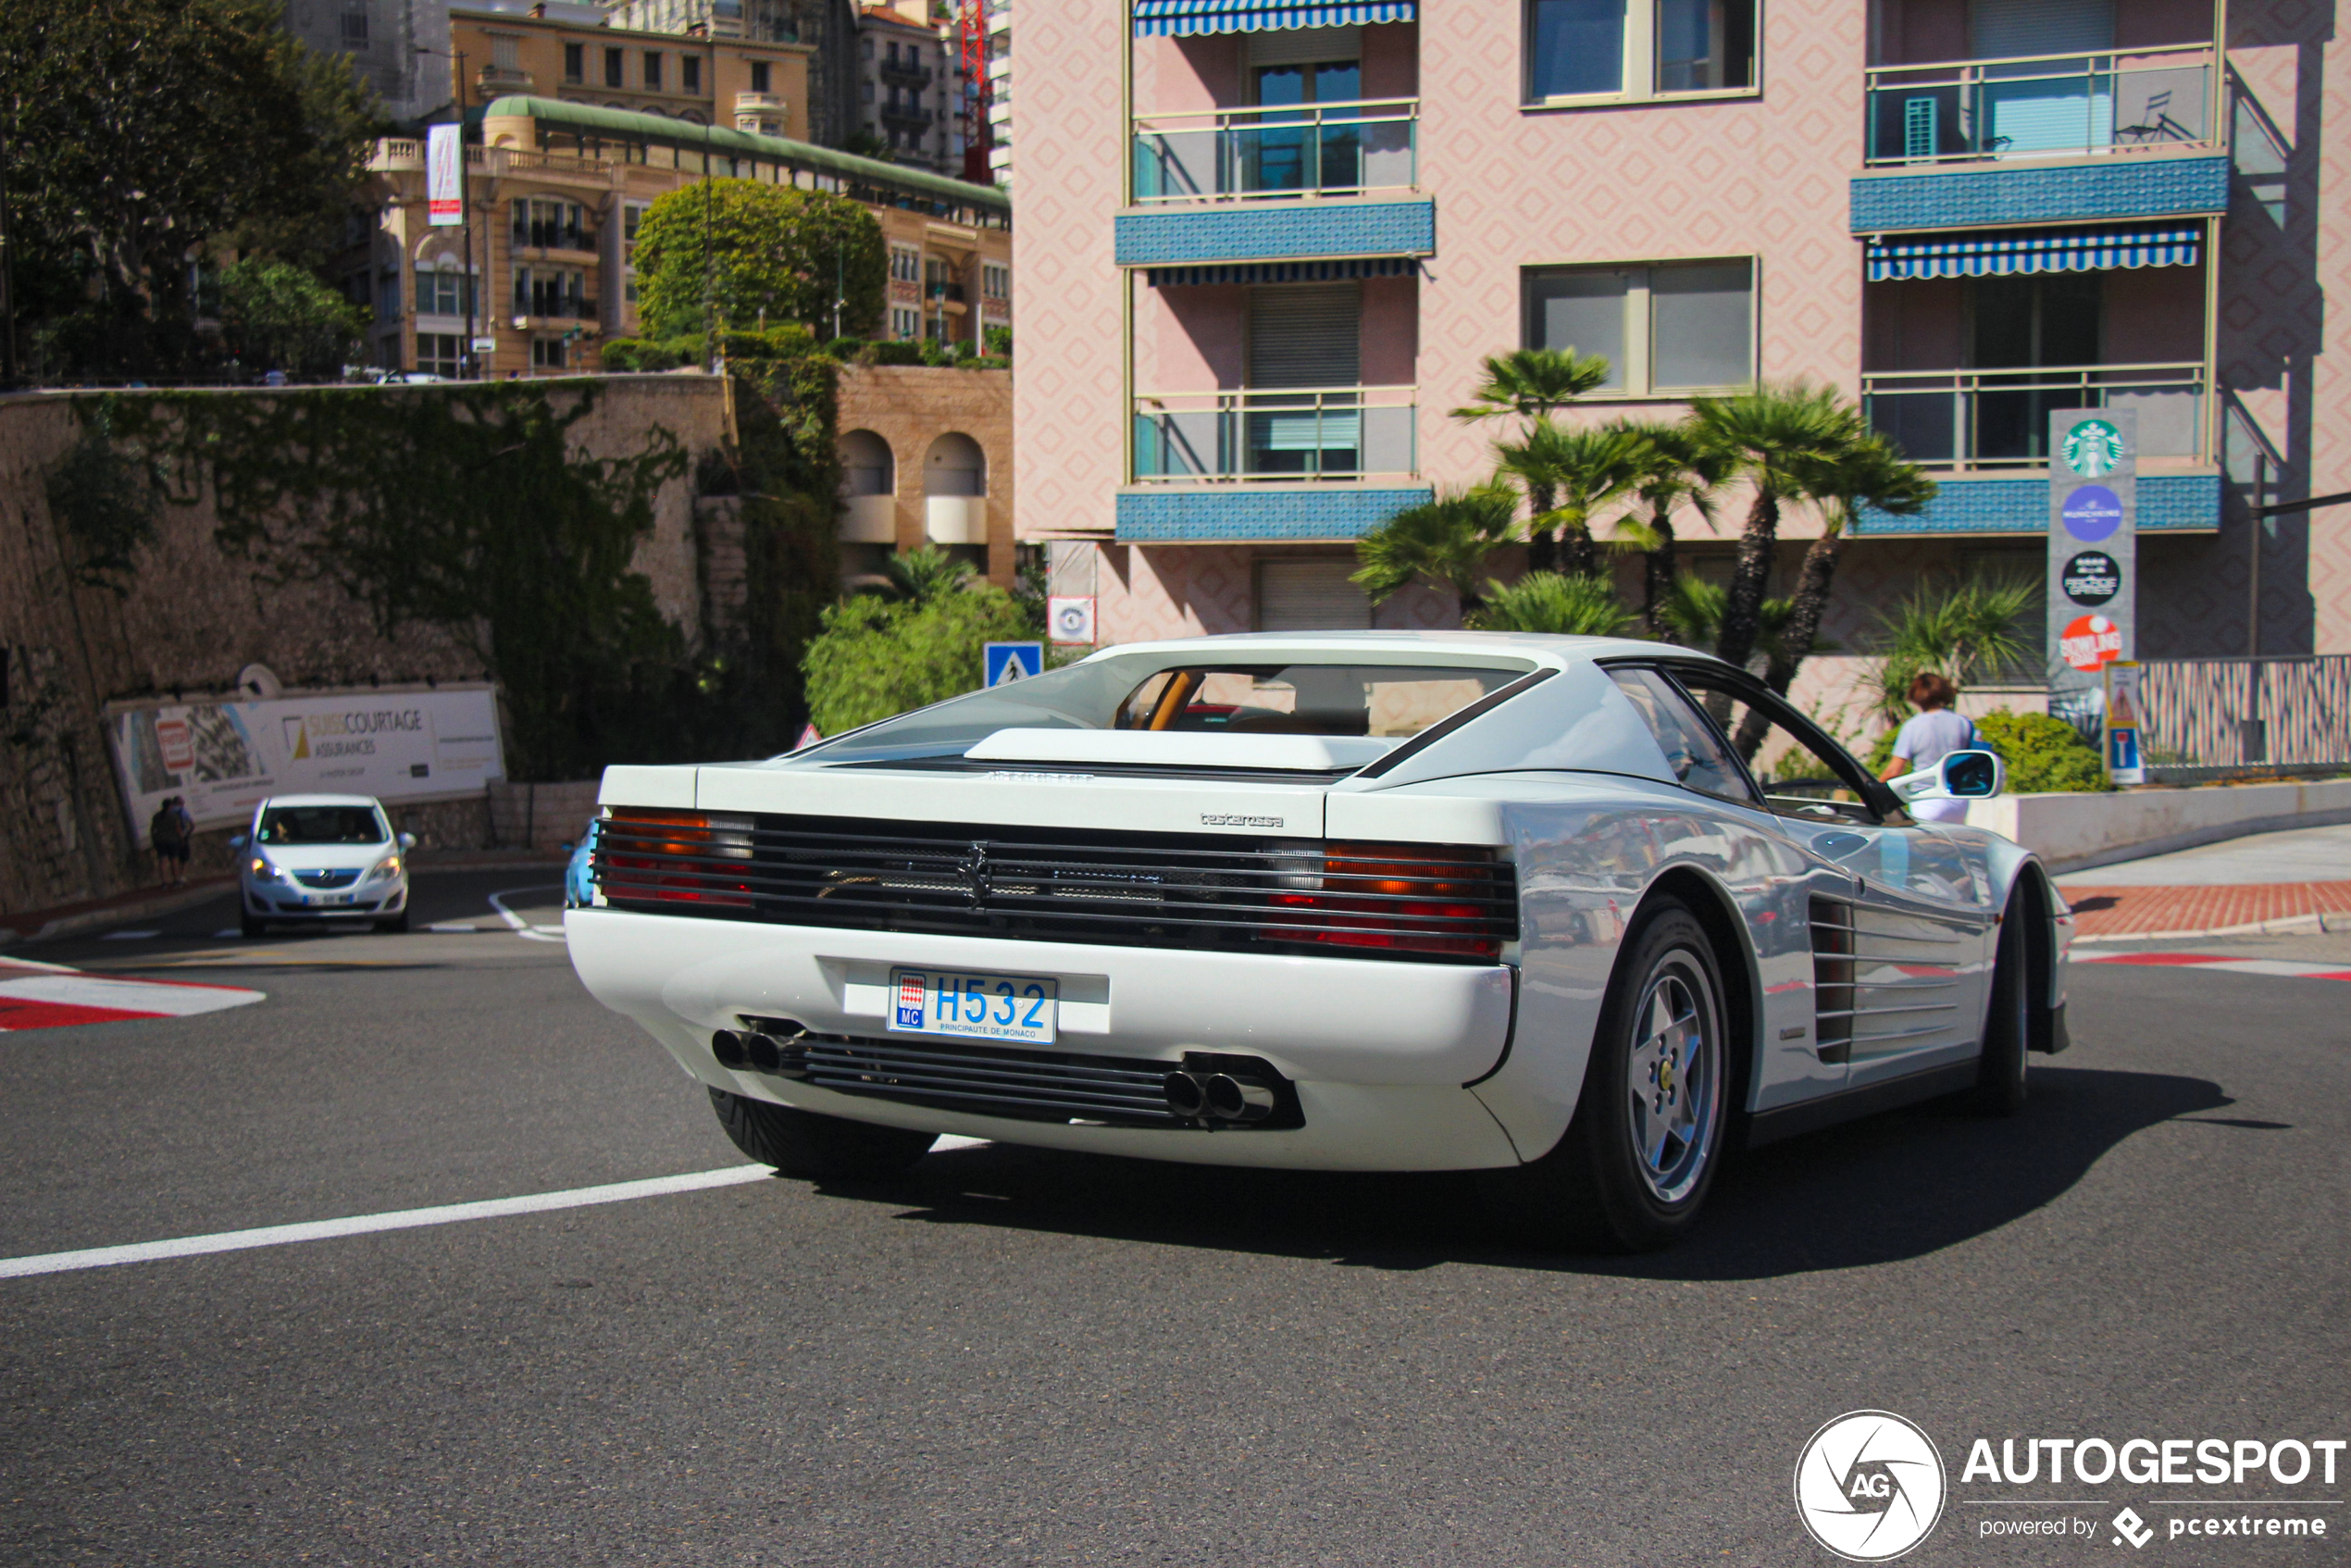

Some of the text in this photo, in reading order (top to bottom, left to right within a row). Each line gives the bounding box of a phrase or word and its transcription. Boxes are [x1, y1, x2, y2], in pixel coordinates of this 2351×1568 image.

[2064, 577, 2118, 587] ARCADE
[2069, 587, 2114, 595] GAMES
[2059, 631, 2121, 657] BOWLING
[315, 739, 376, 758] ASSURANCES
[1200, 812, 1284, 828] testarossa
[936, 977, 1046, 1028] H532
[902, 1009, 919, 1025] MC
[939, 1023, 988, 1034] PRINCIPAUTE
[1003, 1028, 1036, 1039] MONACO
